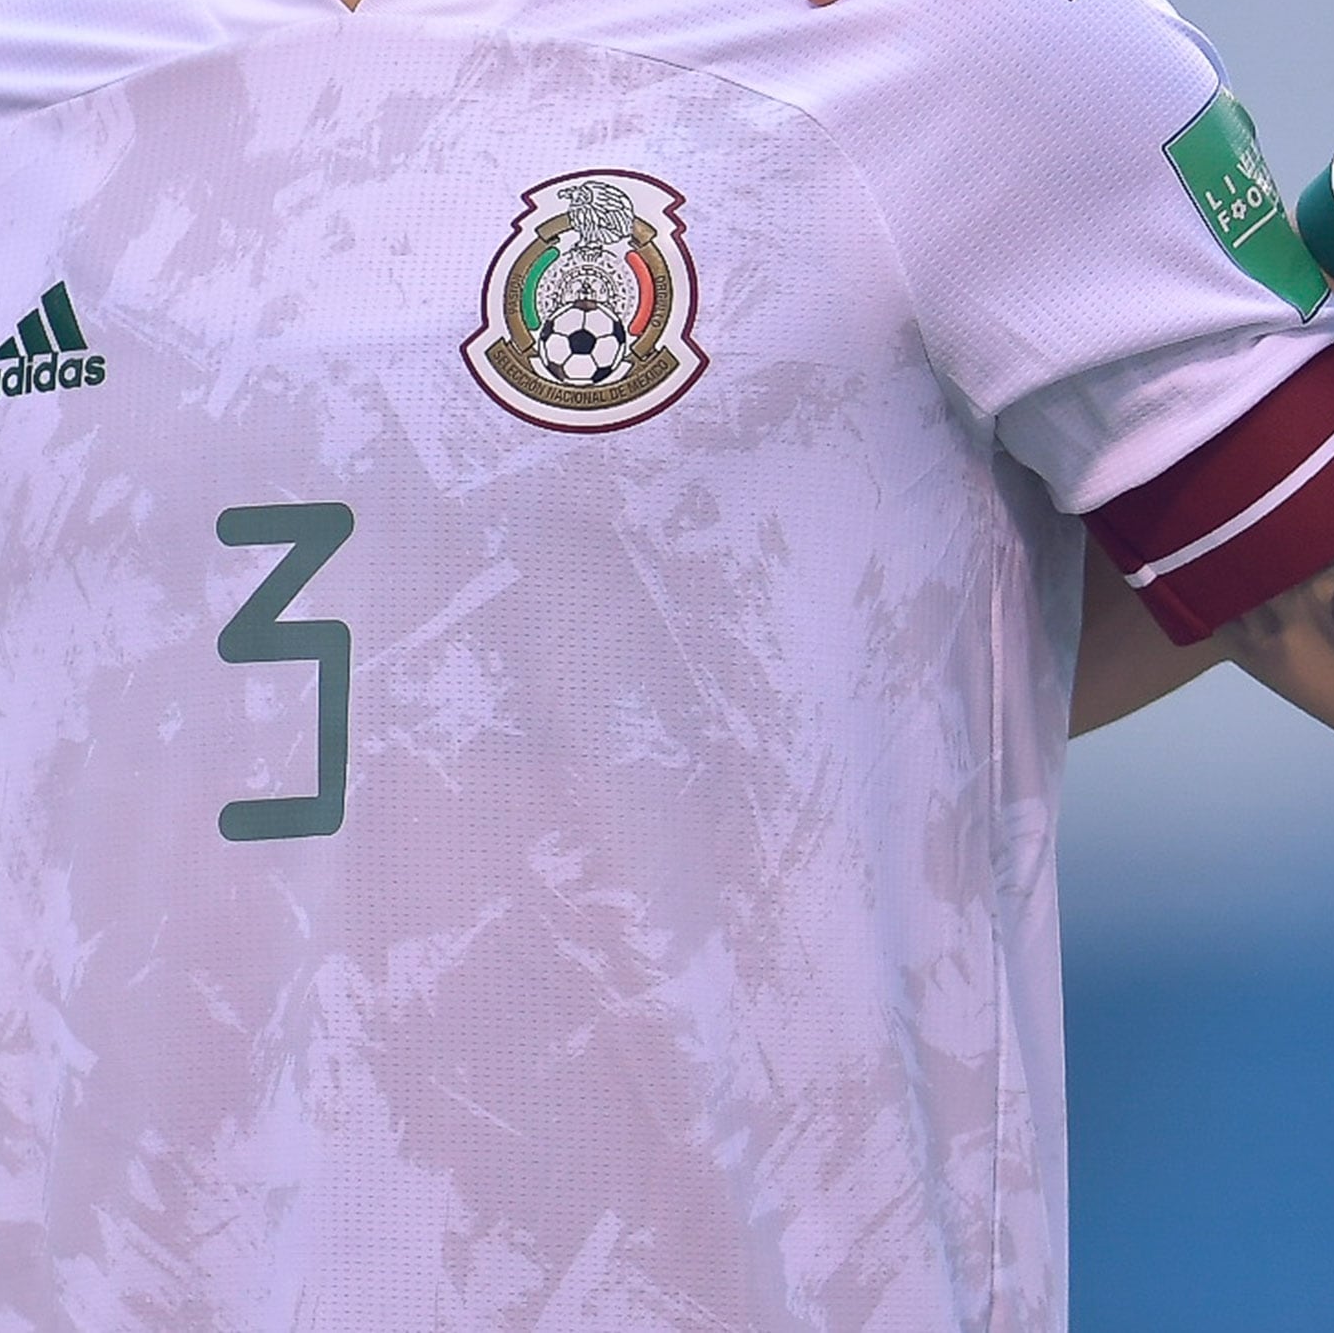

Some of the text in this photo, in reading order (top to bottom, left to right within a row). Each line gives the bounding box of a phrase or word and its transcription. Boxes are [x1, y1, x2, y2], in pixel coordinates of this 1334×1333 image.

[547, 386, 607, 405] NACIONAL
[609, 385, 627, 401] DE
[216, 502, 355, 842] 3
